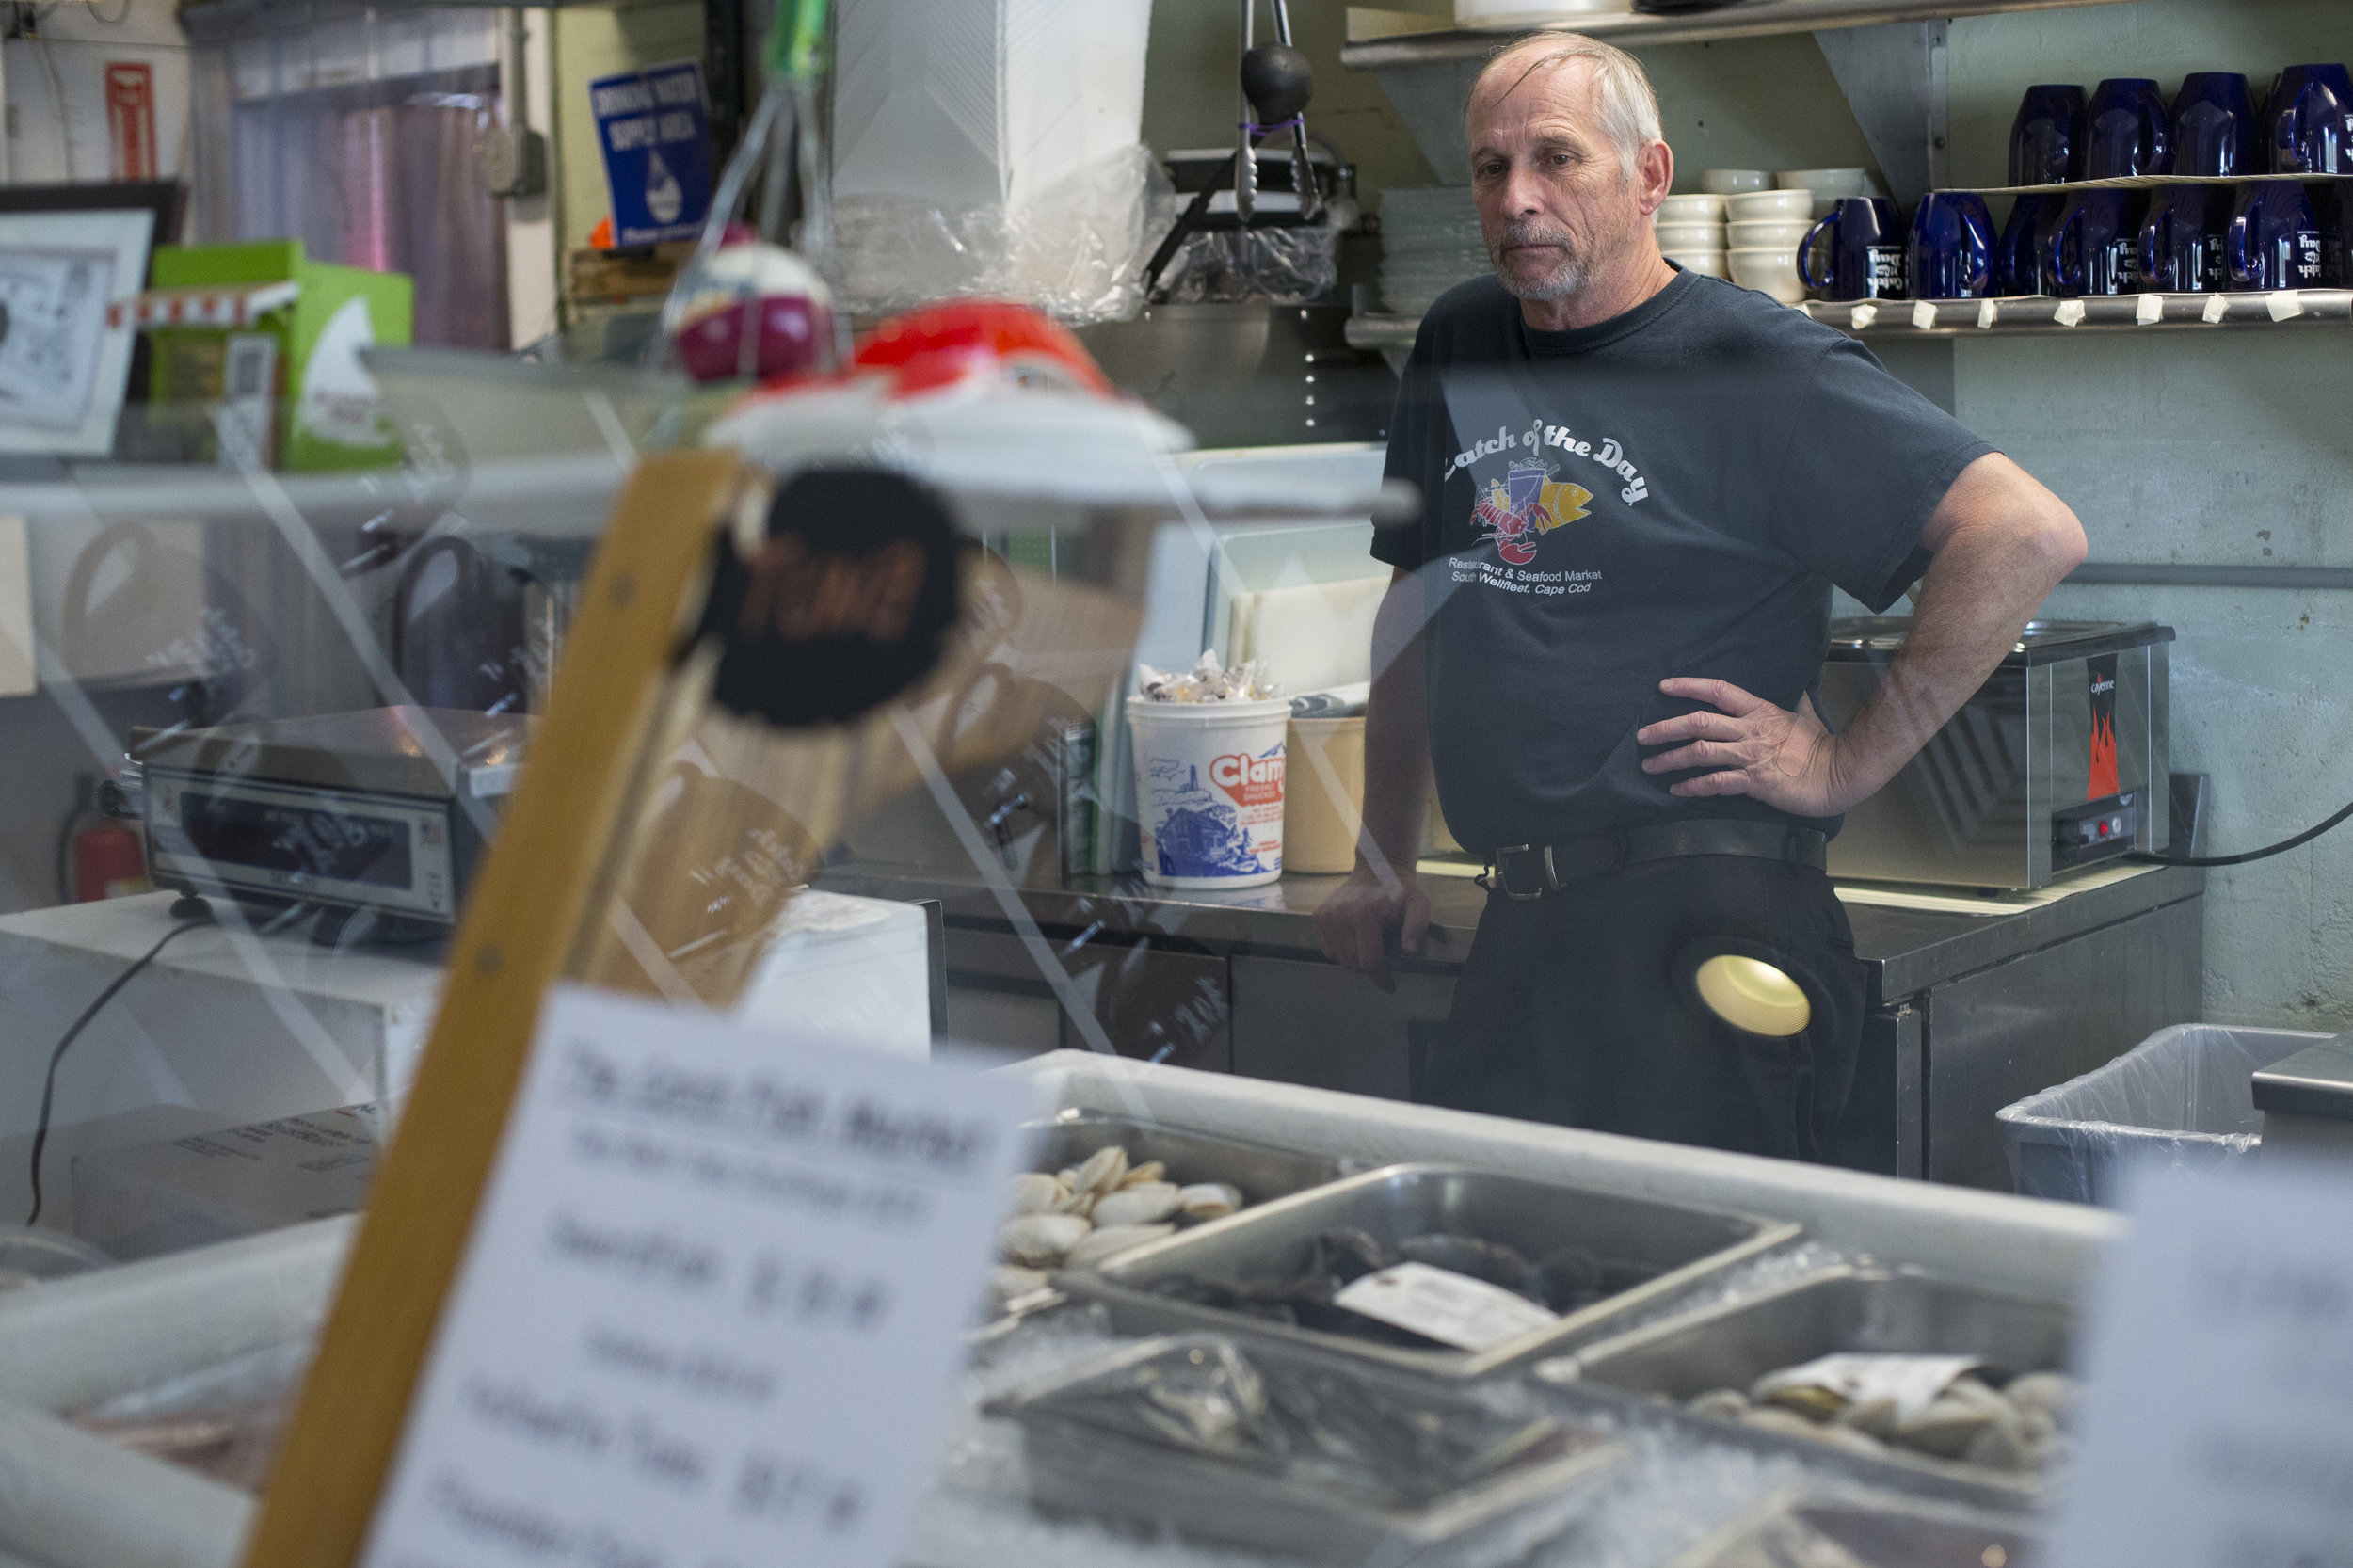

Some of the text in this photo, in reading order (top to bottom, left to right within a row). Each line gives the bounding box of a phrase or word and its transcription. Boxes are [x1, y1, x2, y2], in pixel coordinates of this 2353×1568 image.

[1522, 419, 1543, 456] of
[1543, 425, 1592, 456] the
[1593, 438, 1649, 506] Day
[1451, 571, 1592, 597] South Wellfleet, Cape Cod
[1504, 568, 1514, 580] &
[1517, 570, 1561, 583] Seafood
[1564, 569, 1603, 582] Market
